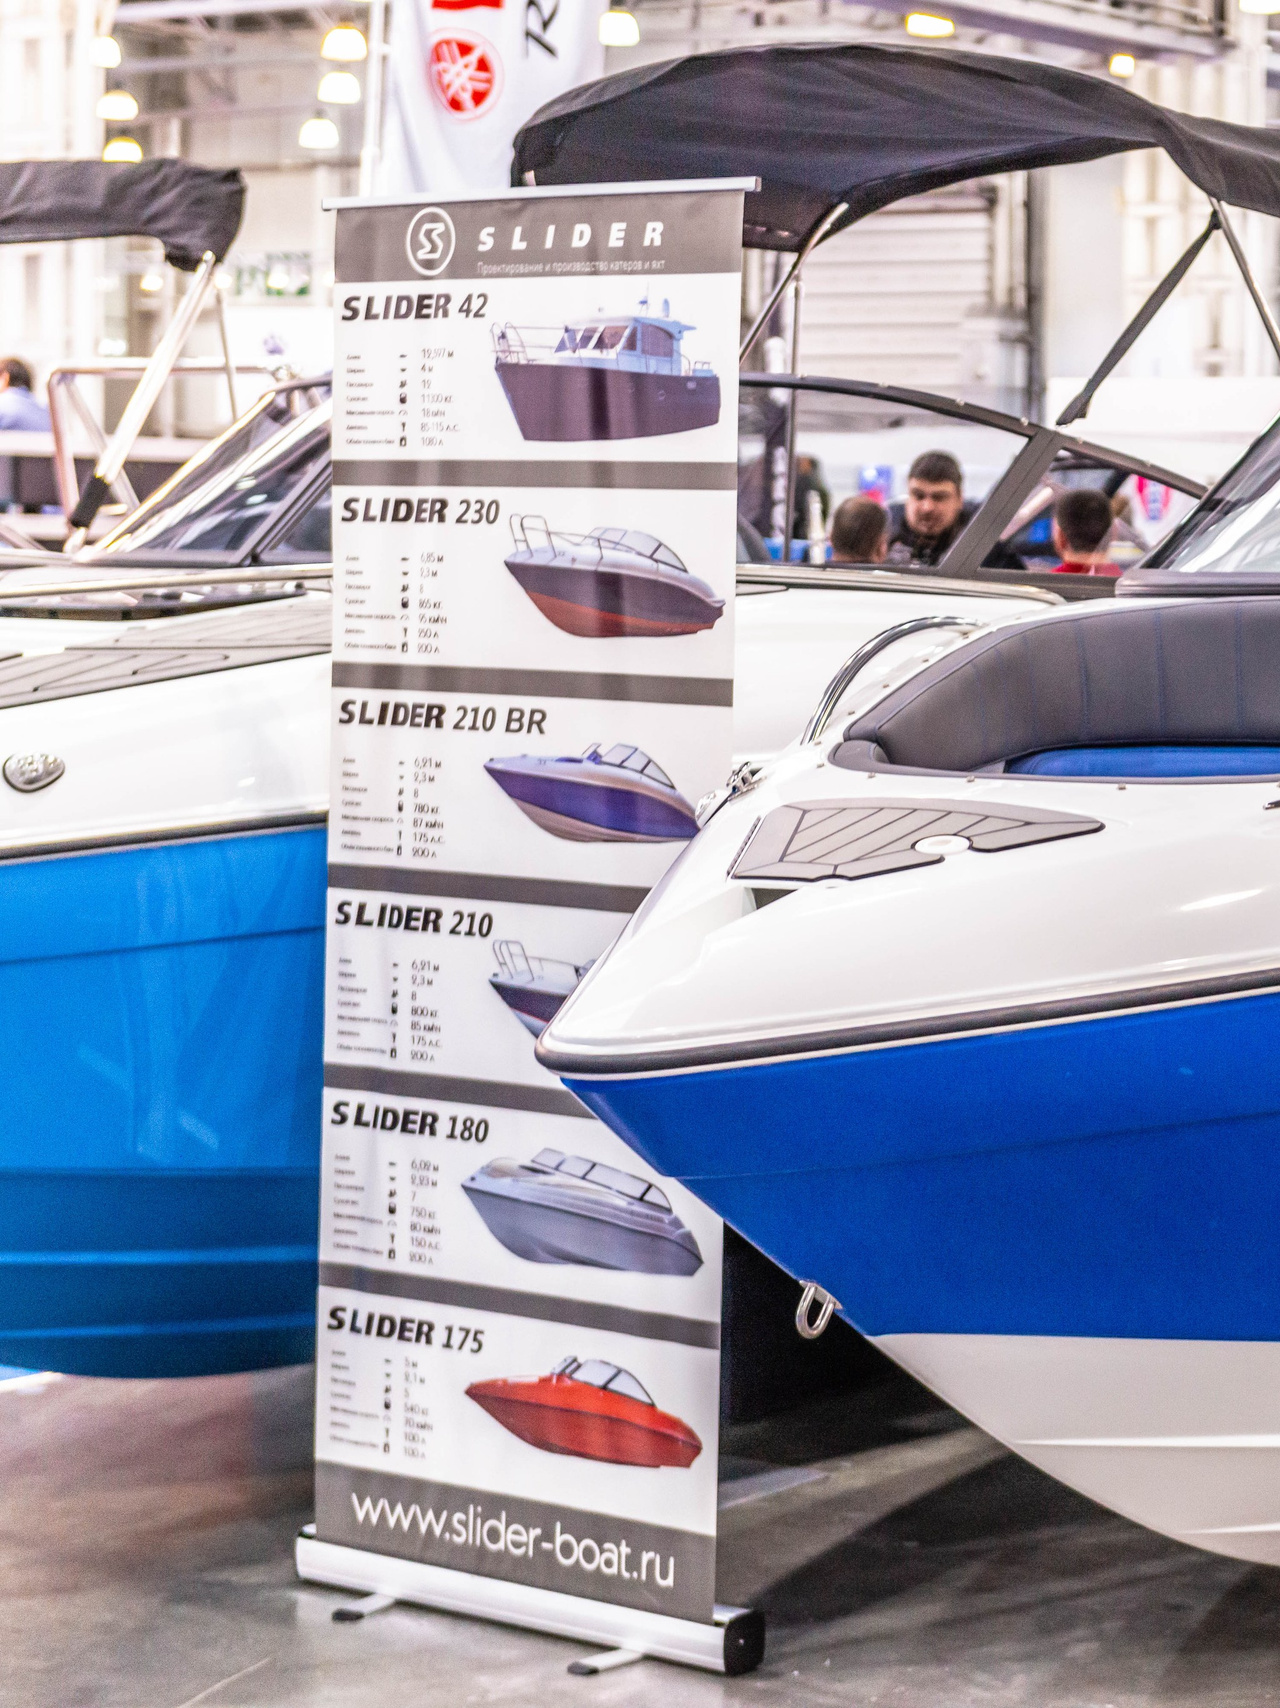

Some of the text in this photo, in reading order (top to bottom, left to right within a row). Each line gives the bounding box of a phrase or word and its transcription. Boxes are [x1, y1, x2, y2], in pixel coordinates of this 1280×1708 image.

[477, 220, 665, 252] SLIDER
[476, 261, 544, 276] Проектирование
[552, 261, 609, 274] производство
[610, 260, 643, 272] катеров
[651, 259, 666, 270] яхт
[341, 292, 489, 321] SLIDER 42
[341, 497, 501, 525] SLIDER 230
[338, 699, 548, 735] SLIDER 210 BR
[413, 788, 419, 799] 8
[335, 900, 494, 938] SLIDER 210
[411, 990, 417, 1001] 8
[331, 1100, 490, 1143] SLIDER 180
[327, 1306, 485, 1355] SLIDER 175
[351, 1491, 675, 1588] www.slider-boat.ru
